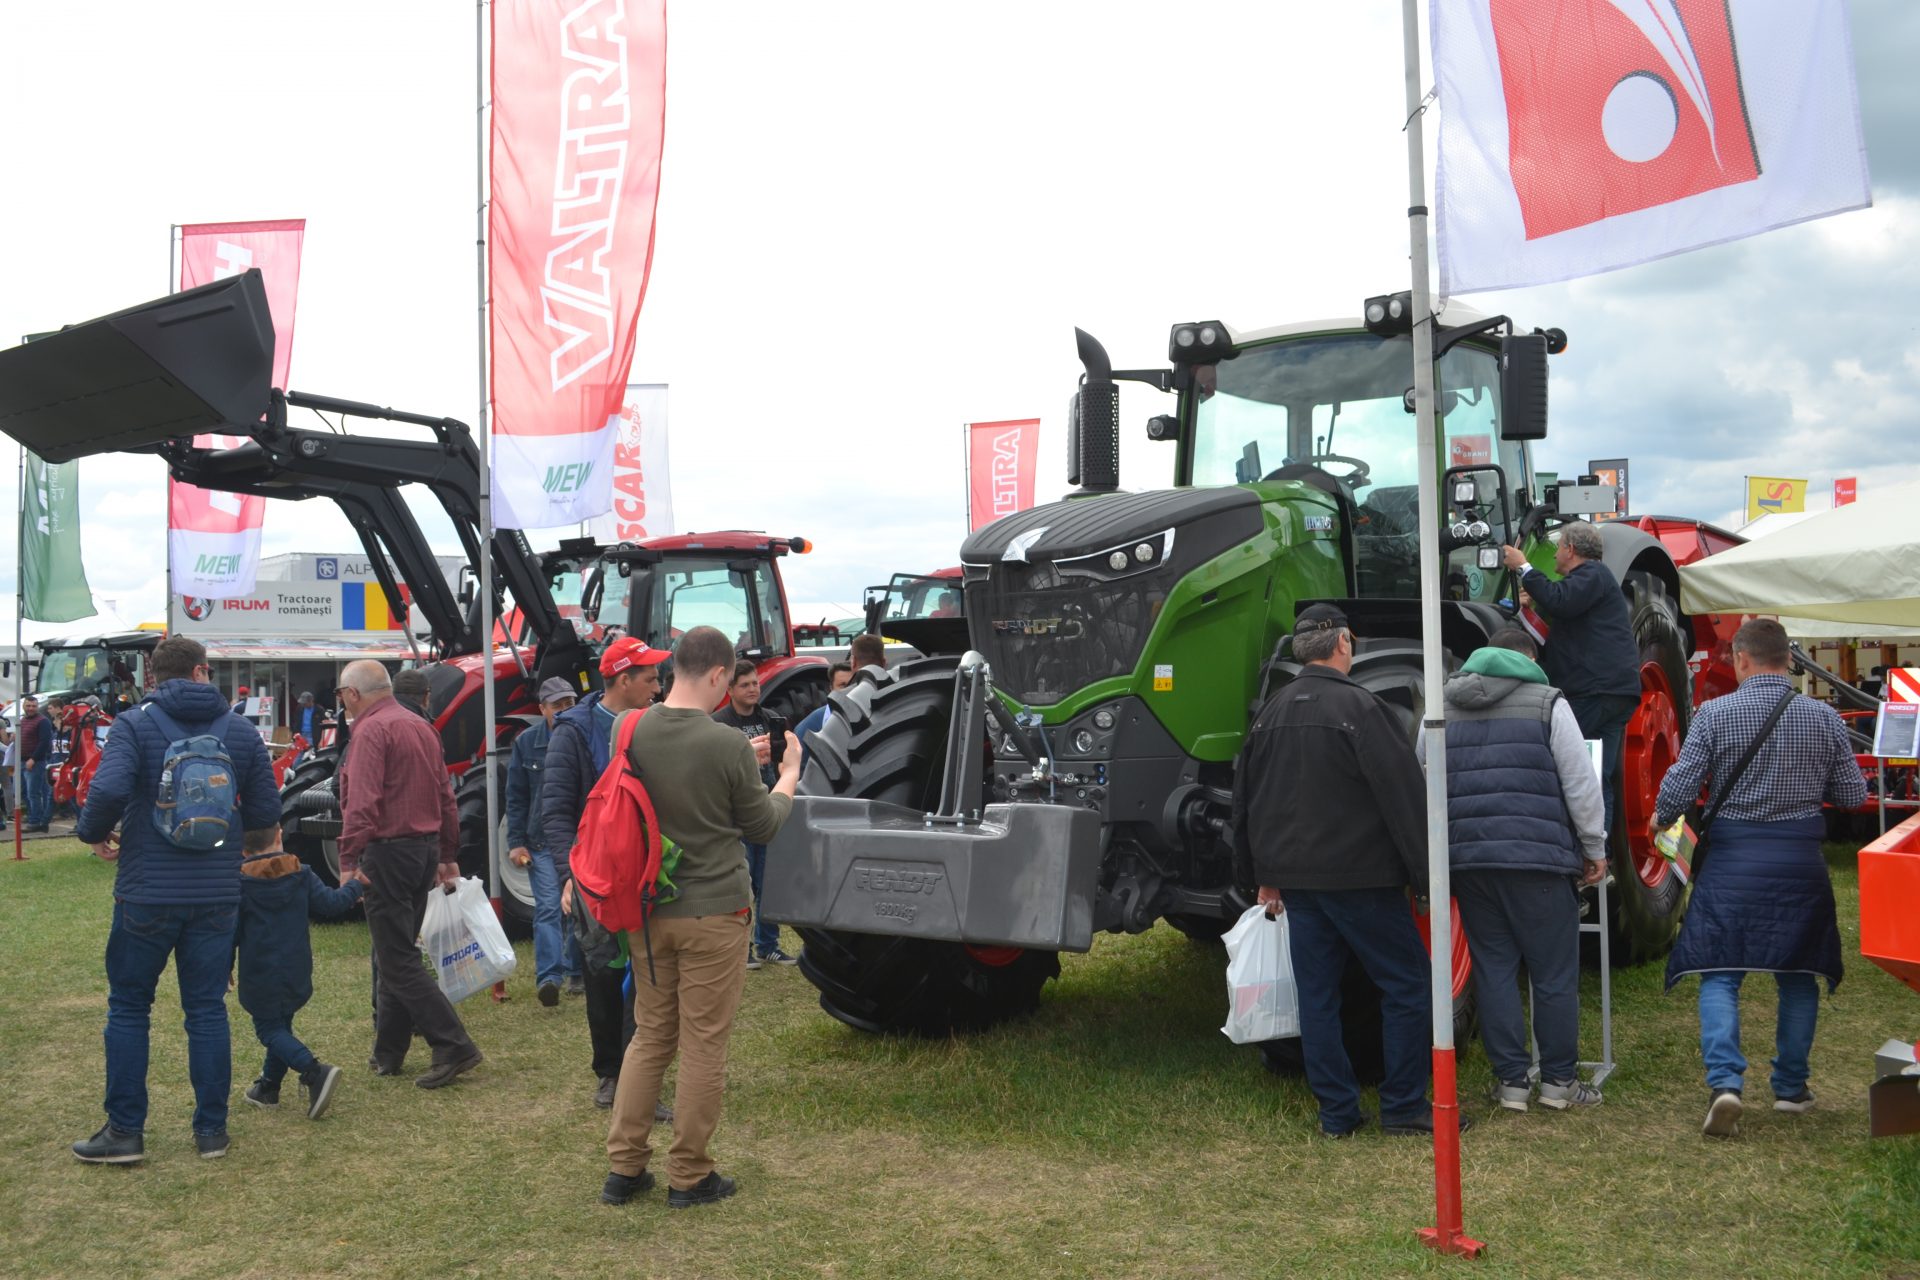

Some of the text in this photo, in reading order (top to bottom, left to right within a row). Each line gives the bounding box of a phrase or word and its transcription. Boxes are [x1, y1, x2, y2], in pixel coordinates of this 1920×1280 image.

[539, 0, 631, 392] VALTRA
[992, 427, 1022, 515] LTRA
[344, 564, 396, 575] ALPA
[223, 594, 332, 611] IRUM Tractoare
[854, 867, 944, 895] FENDT
